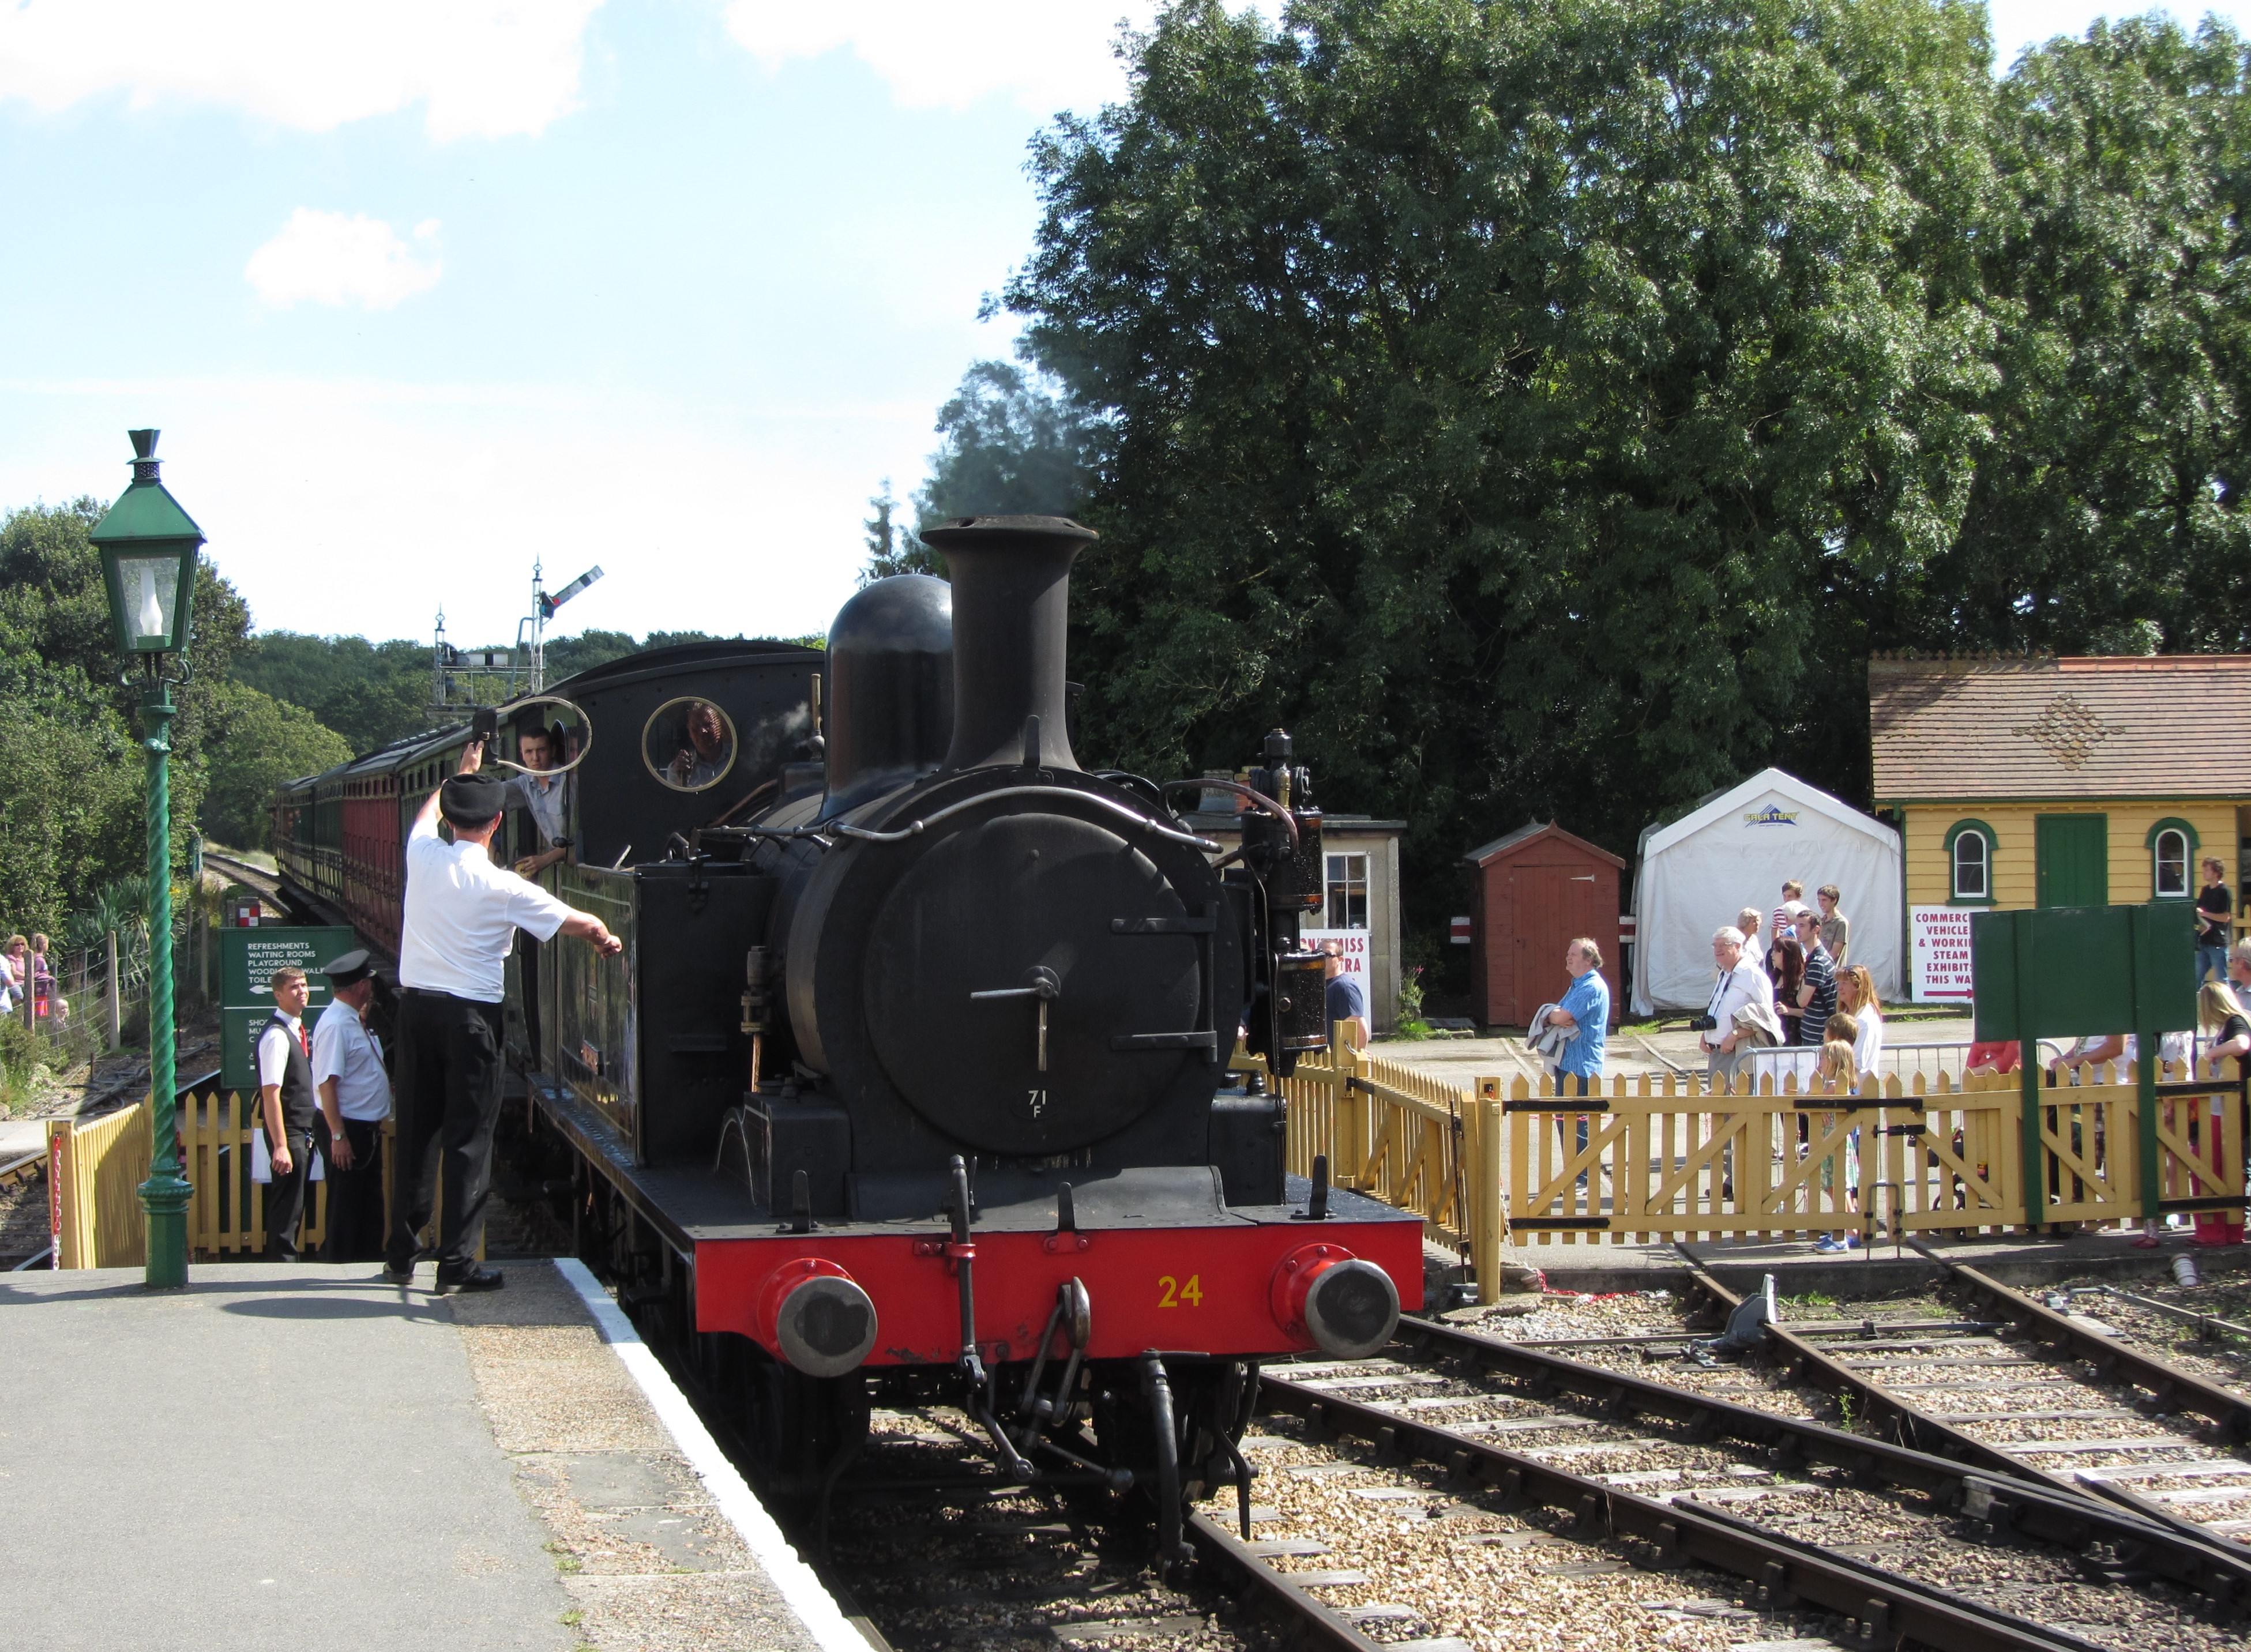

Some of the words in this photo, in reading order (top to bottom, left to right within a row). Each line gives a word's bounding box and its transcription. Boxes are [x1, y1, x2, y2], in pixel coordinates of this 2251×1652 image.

[1772, 812, 1798, 821] TENT
[1915, 913, 1968, 923] COMMERC
[1927, 926, 1970, 935] VEHICLE
[1919, 938, 1926, 947] &
[1933, 951, 1968, 959] STEAM
[1926, 975, 1949, 984] THIS
[1955, 975, 1971, 984] WA
[1028, 1090, 1046, 1105] 71
[1034, 1105, 1041, 1118] F
[1158, 1274, 1203, 1308] 24
